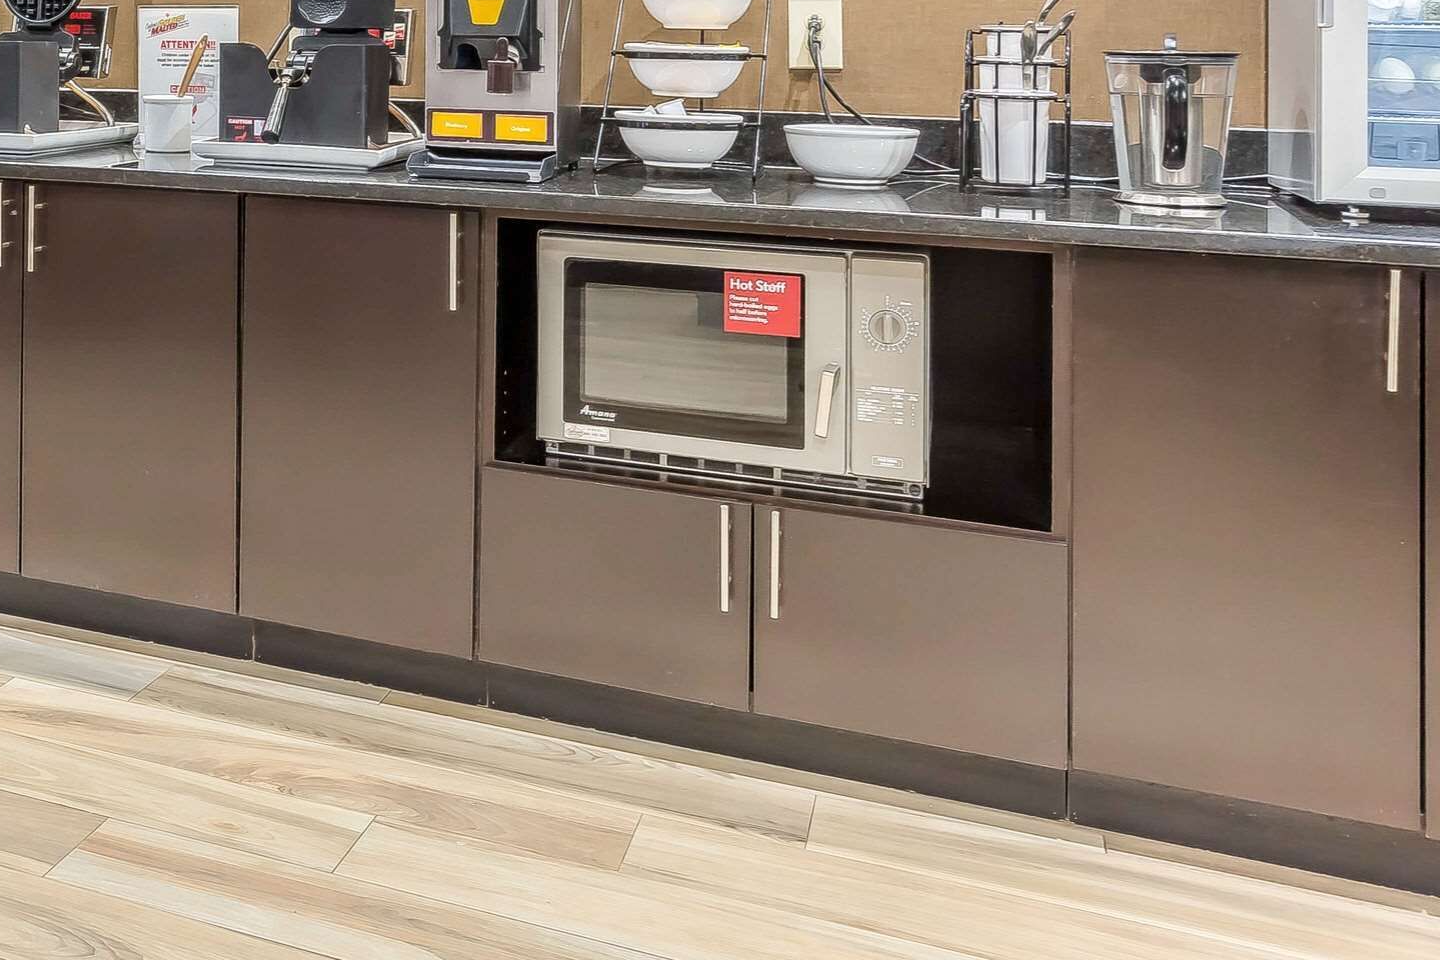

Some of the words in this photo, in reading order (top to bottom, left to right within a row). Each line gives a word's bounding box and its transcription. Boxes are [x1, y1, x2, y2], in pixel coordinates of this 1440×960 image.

[160, 40, 216, 49] ATTENTN!!
[170, 85, 206, 94] CTION
[729, 278, 753, 291] Hot
[579, 404, 617, 418] Amana
